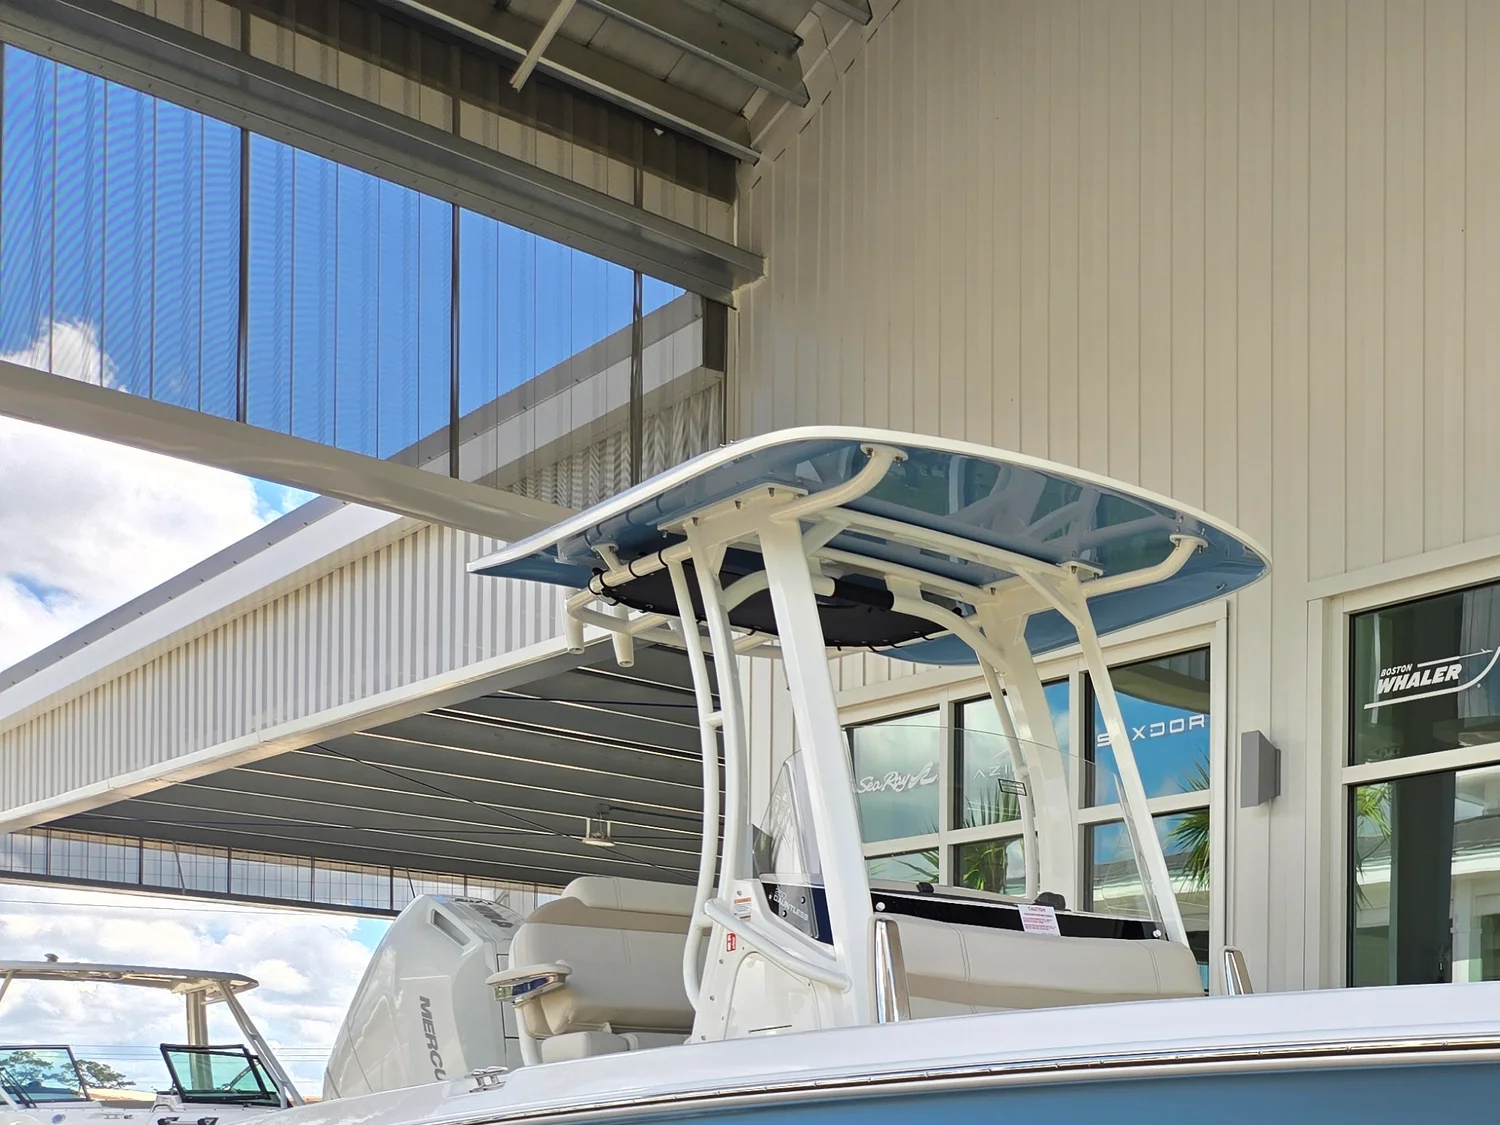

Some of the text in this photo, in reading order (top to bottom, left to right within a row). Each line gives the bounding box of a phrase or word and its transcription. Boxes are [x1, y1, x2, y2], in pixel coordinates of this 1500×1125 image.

[1376, 663, 1463, 695] WHALER
[1380, 663, 1413, 677] BOSTON
[1097, 714, 1205, 748] SXDOR
[858, 771, 910, 793] Sea Ray
